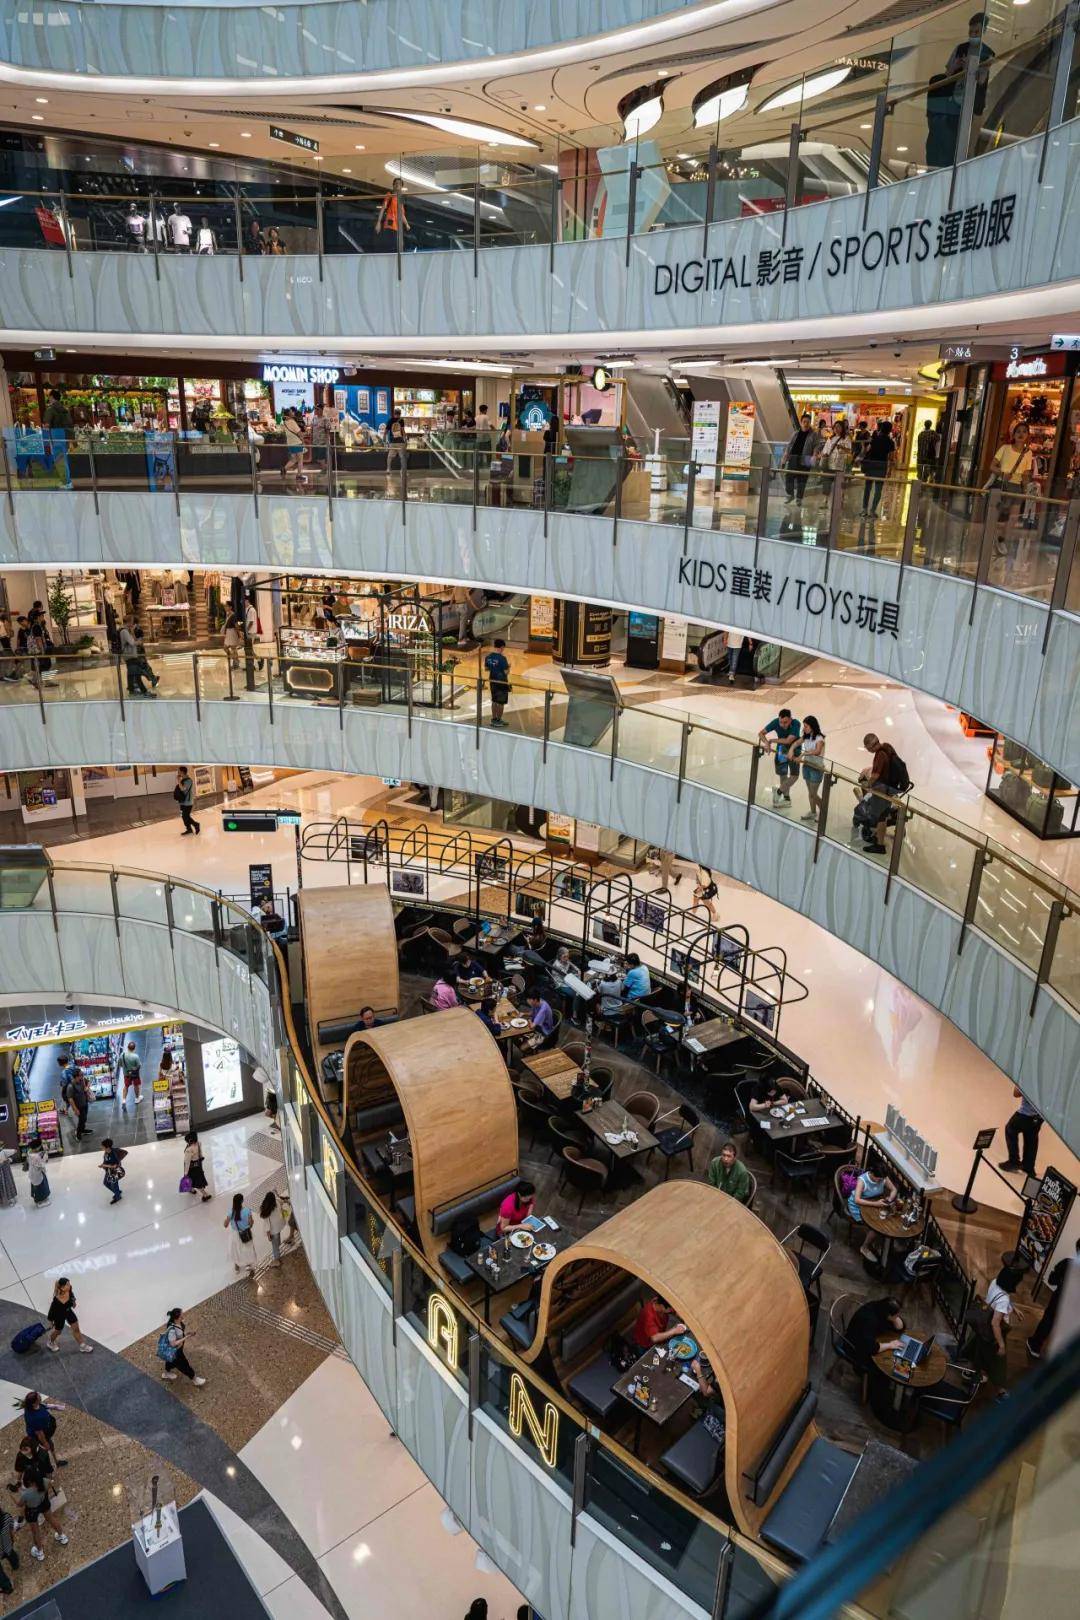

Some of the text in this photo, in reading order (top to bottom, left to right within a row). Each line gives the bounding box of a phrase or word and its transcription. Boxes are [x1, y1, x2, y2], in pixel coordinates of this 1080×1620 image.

[654, 193, 1017, 296] DIGITAL 影音 / SPORTS 運動服
[1010, 347, 1018, 360] 3
[263, 365, 340, 384] MOOMIN SHOP
[678, 557, 901, 640] KIDS 童裝 / TOYS 玩具
[387, 613, 430, 632] IRIZA
[6, 1019, 88, 1042] マツモトキヨシ
[97, 1012, 145, 1027] matsukiyo
